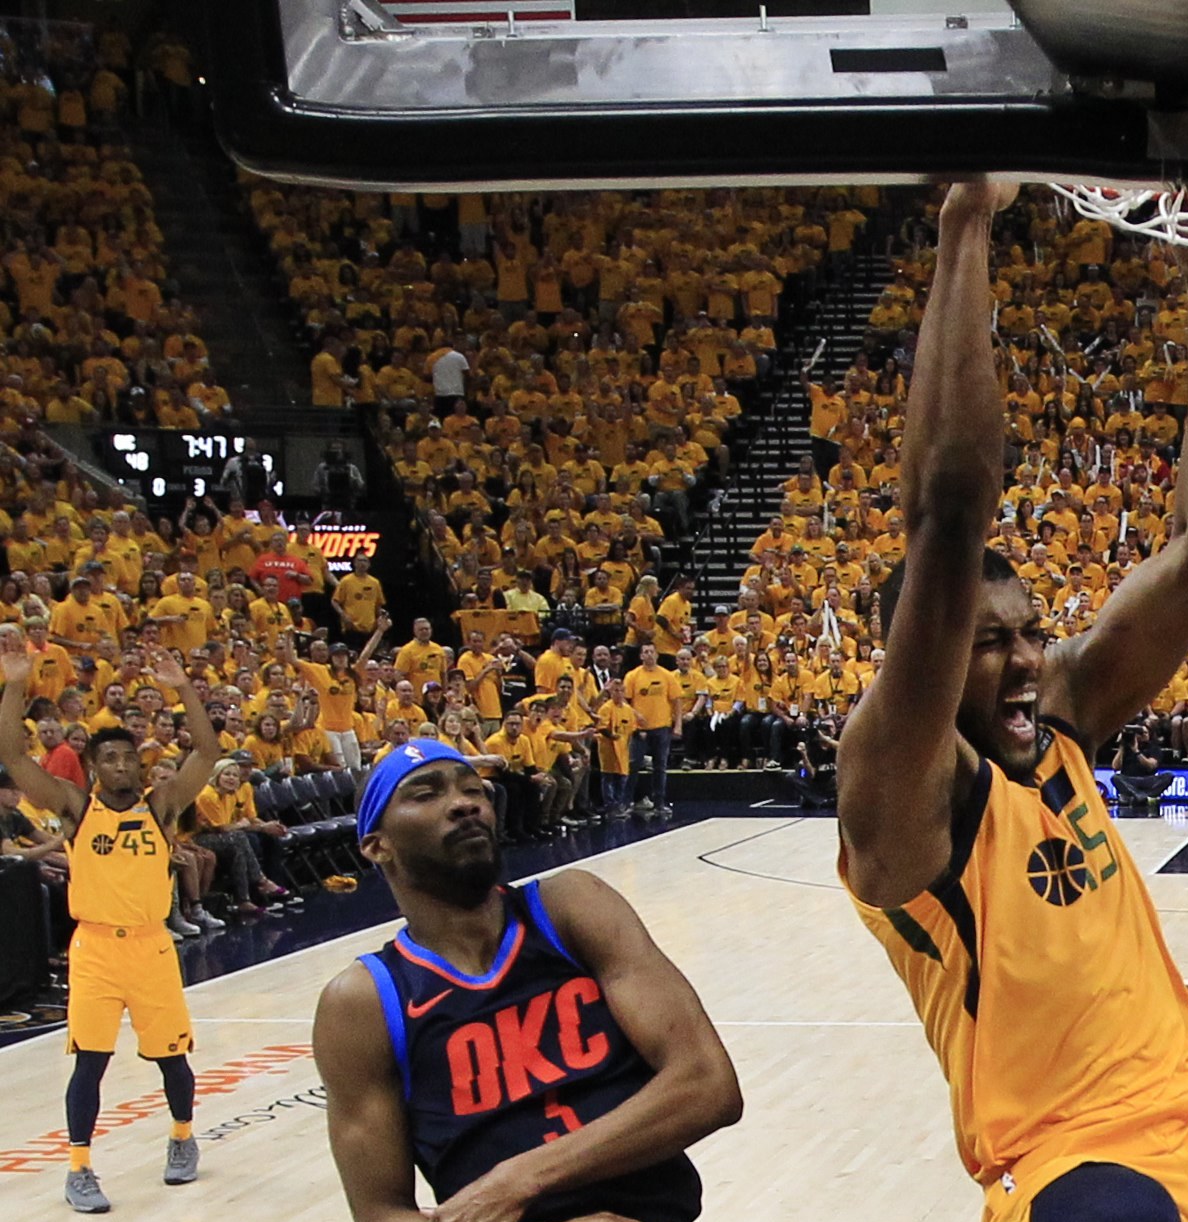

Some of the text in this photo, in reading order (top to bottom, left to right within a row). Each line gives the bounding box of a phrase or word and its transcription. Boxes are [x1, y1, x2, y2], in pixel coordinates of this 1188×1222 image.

[182, 435, 227, 458] 7:47
[194, 478, 205, 496] 3
[121, 830, 156, 856] 45
[446, 976, 610, 1116] OKC
